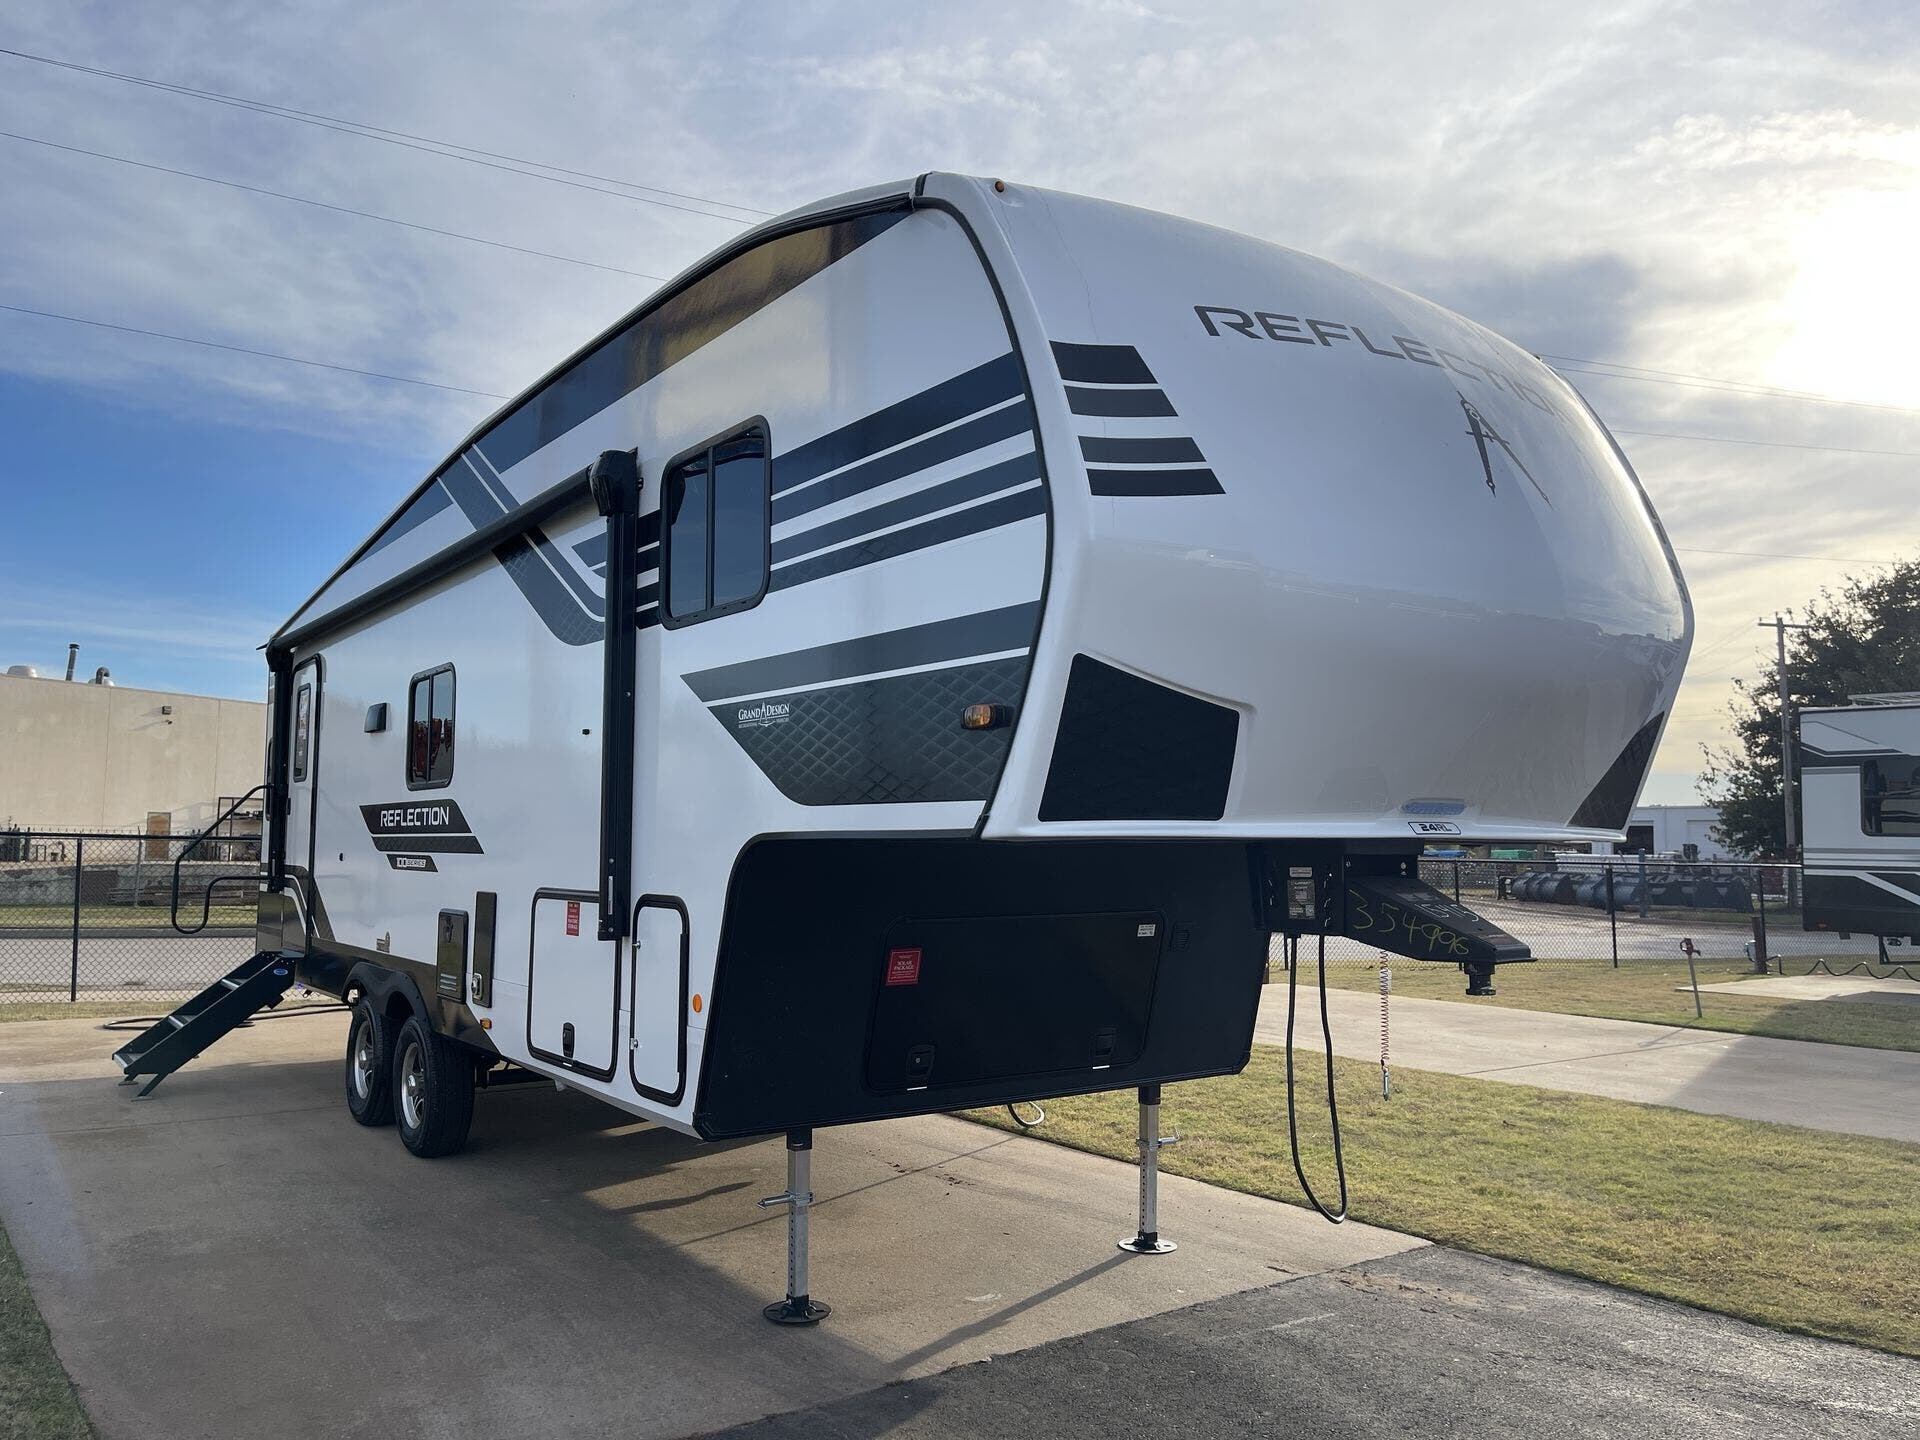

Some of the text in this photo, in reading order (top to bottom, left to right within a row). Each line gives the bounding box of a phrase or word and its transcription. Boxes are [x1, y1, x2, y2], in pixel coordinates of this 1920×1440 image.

[738, 703, 790, 720] GRAND DESIGN
[380, 807, 449, 827] REFLECTION
